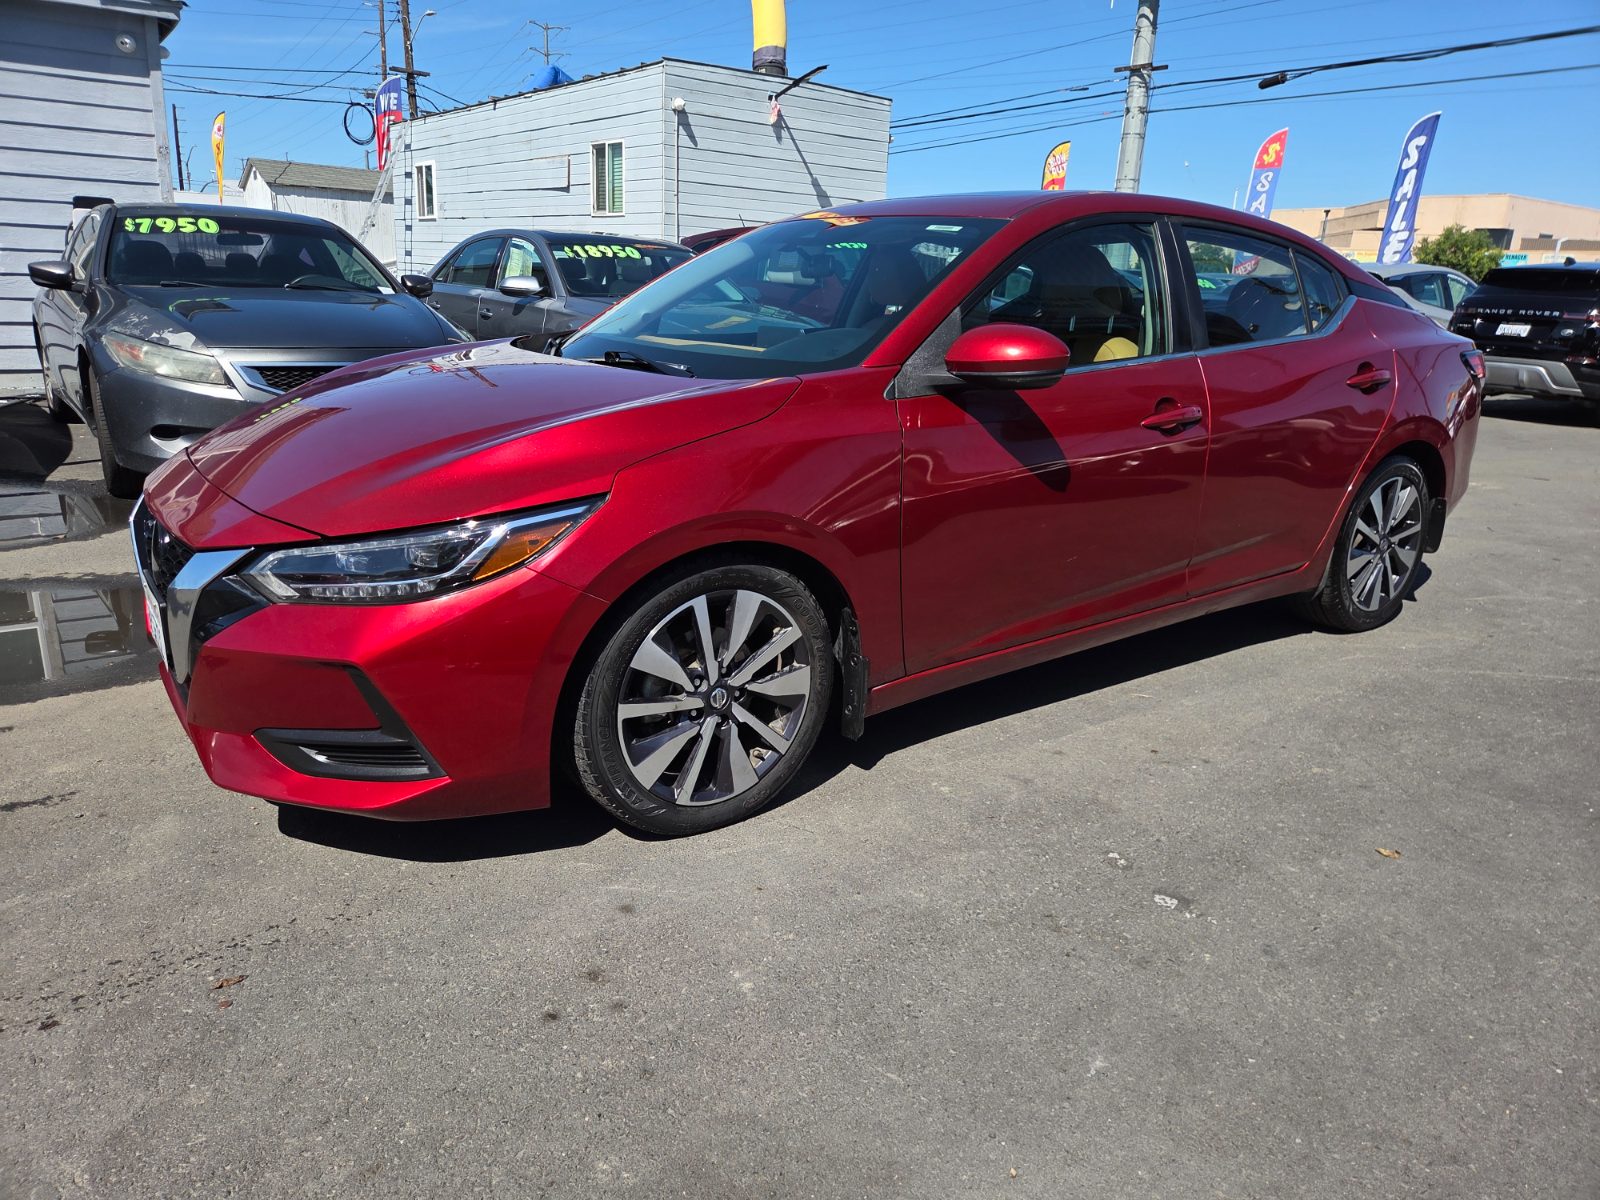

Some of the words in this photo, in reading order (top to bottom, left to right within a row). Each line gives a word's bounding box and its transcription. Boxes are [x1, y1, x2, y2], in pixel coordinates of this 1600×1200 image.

[379, 92, 399, 112] WE
[1250, 171, 1274, 218] SA
[1383, 135, 1427, 265] SALE
[124, 217, 220, 234] $7950
[563, 244, 642, 259] $18950
[1518, 309, 1561, 317] ROVER
[793, 597, 828, 689] GOODYEAR
[599, 716, 642, 807] ASSURANCE
